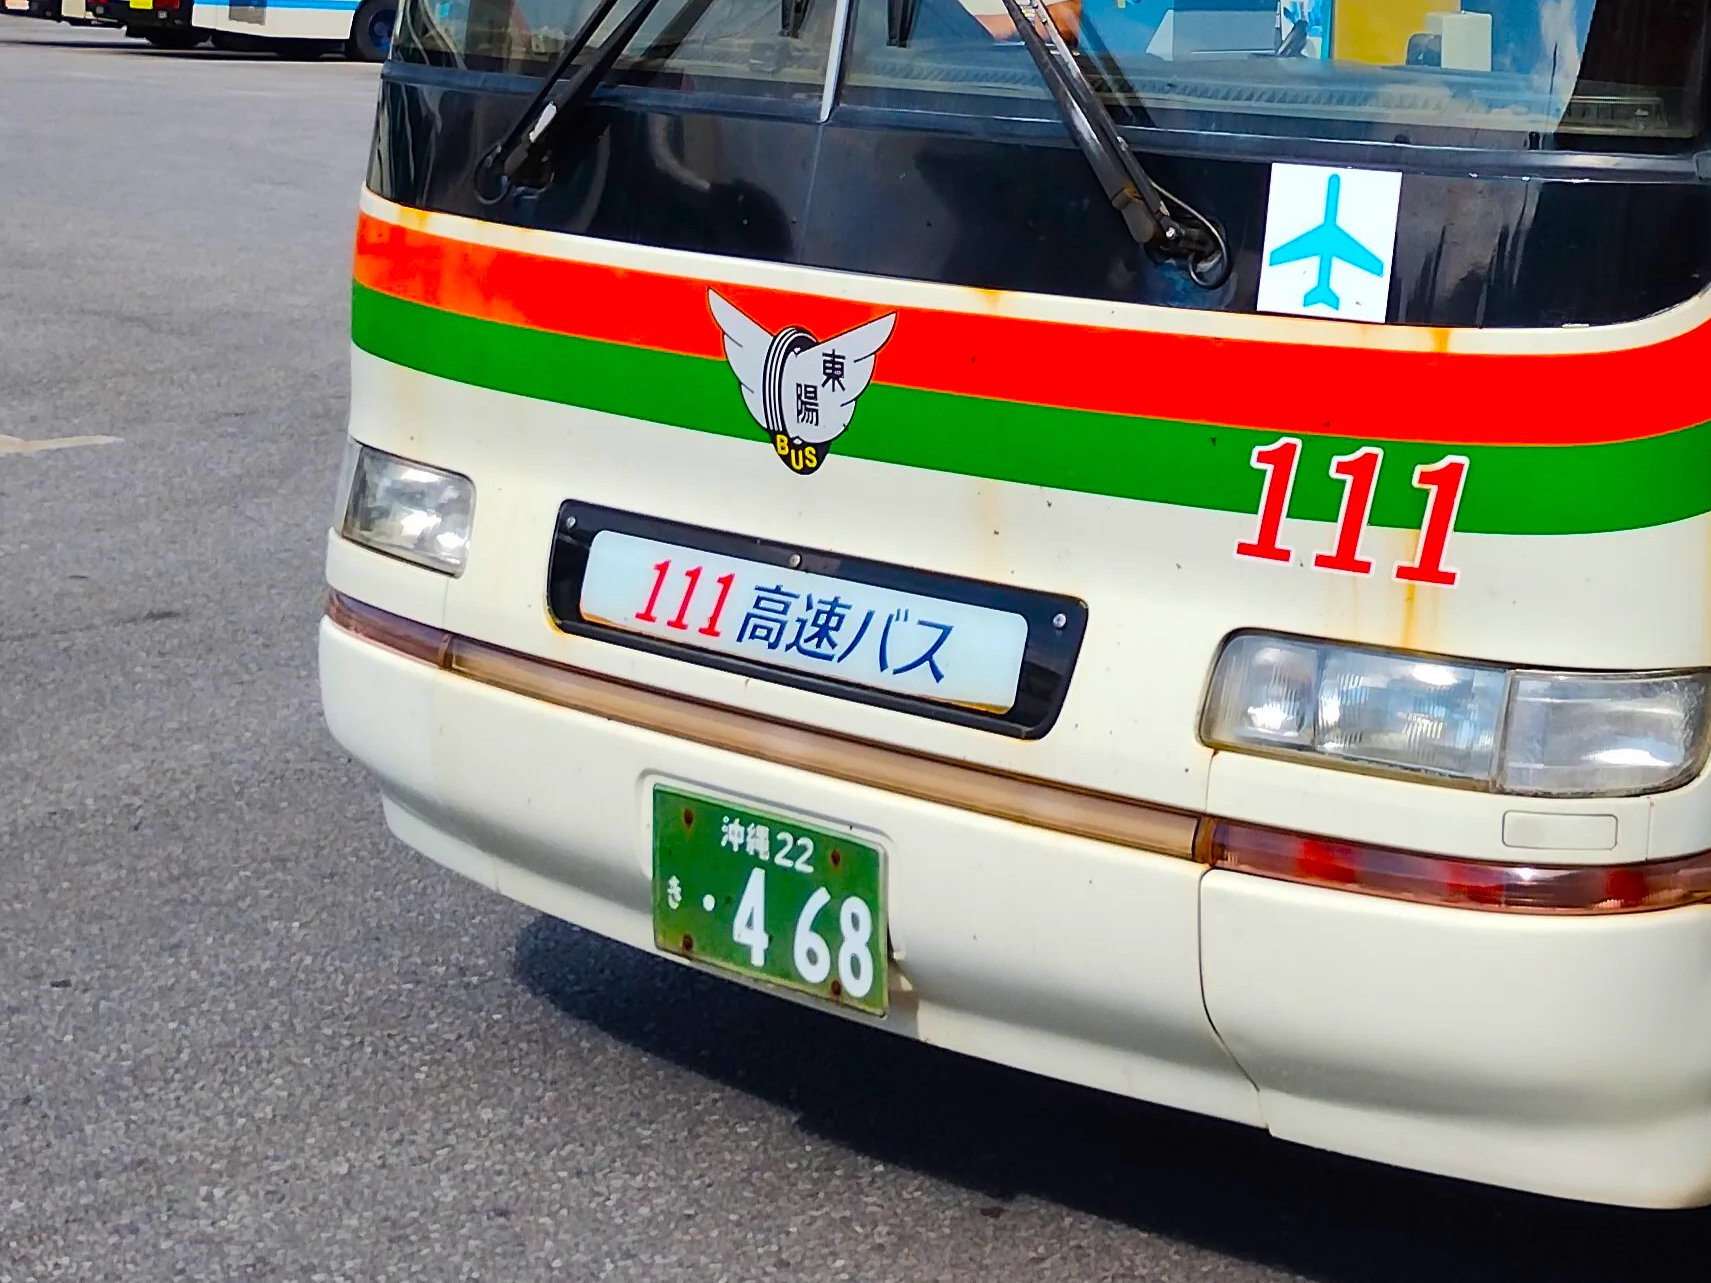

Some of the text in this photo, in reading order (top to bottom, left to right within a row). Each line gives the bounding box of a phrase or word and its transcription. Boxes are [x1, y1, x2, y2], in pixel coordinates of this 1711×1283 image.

[776, 434, 818, 471] BUS
[1235, 438, 1469, 587] 111
[635, 558, 954, 684] 111 高速バス
